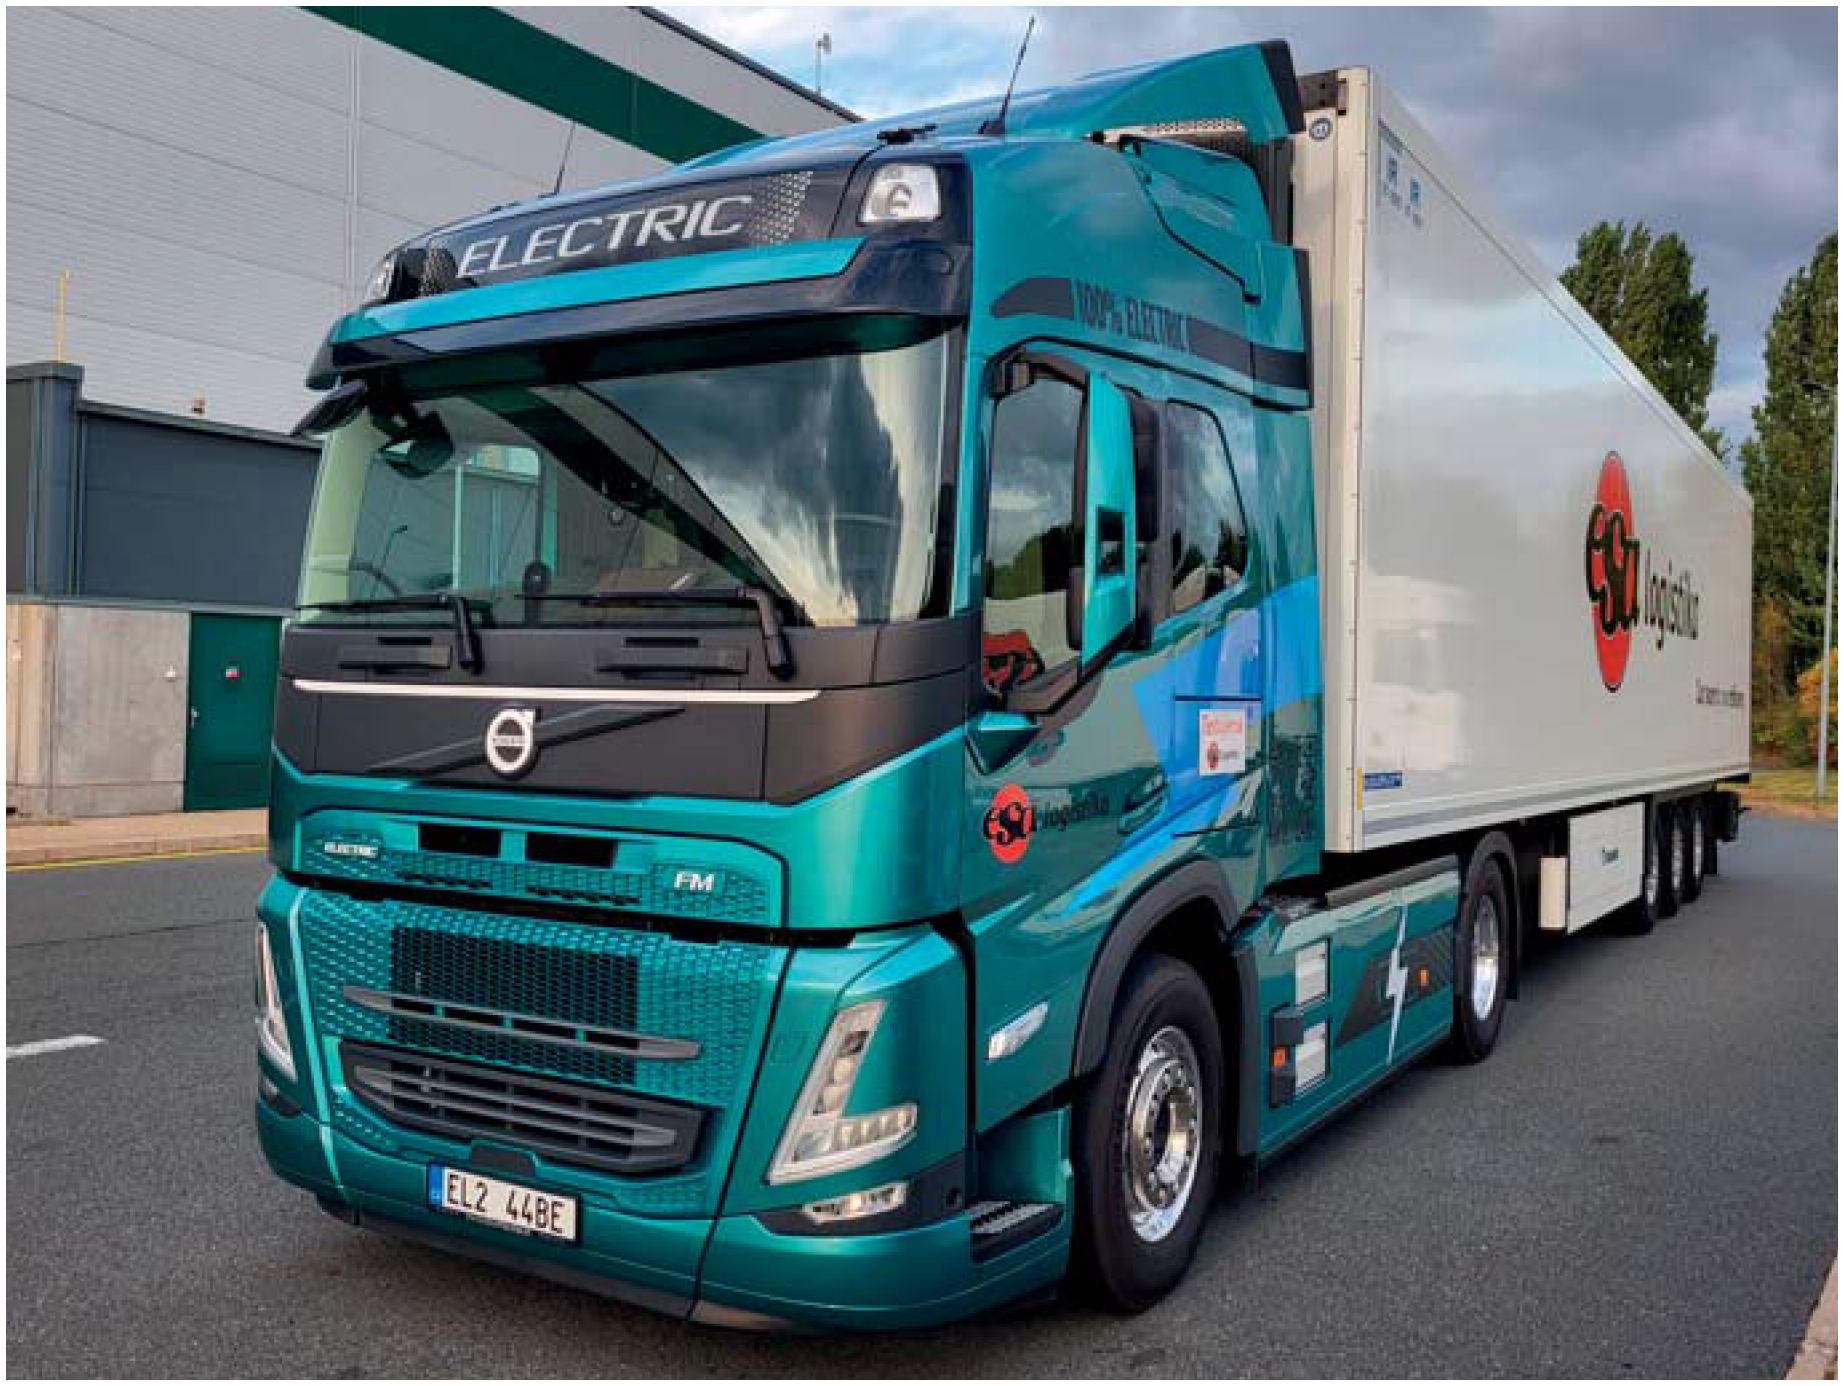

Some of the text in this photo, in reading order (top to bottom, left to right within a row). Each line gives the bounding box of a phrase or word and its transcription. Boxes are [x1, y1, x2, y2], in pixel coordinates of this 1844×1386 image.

[456, 195, 752, 279] ELECTRIC
[1069, 277, 1187, 353] 100% ELECTRIC
[1645, 549, 1698, 650] logistika
[1041, 788, 1111, 832] logistika
[674, 870, 715, 891] FM
[448, 1173, 565, 1234] EL2 44BE
